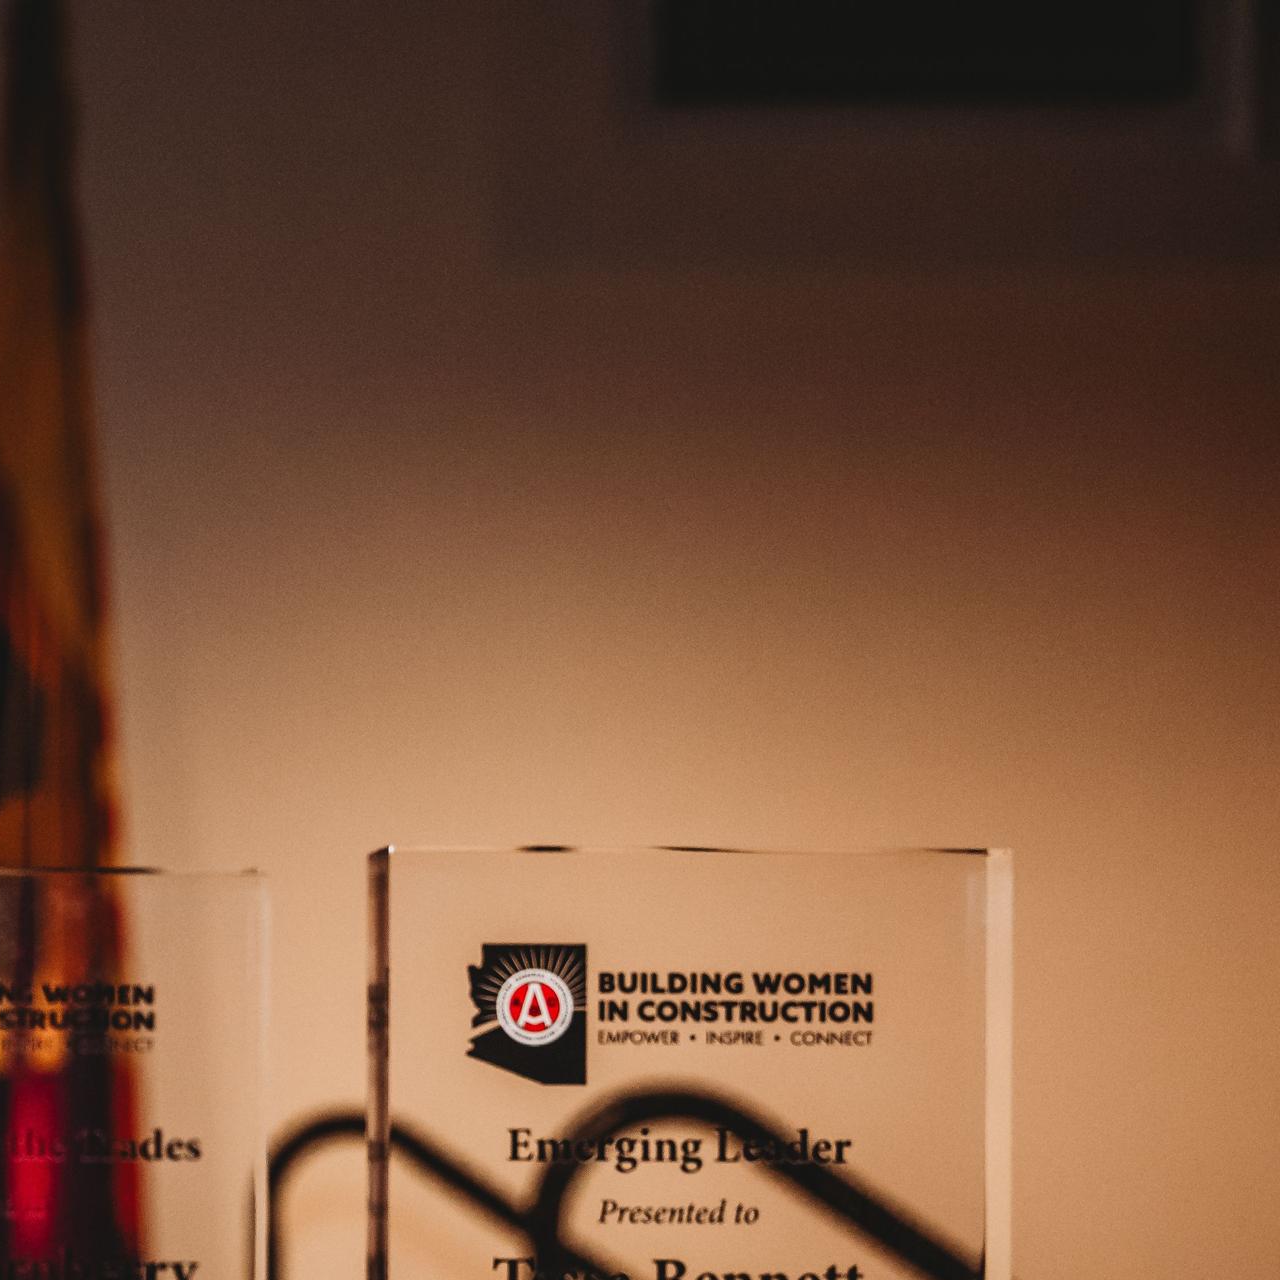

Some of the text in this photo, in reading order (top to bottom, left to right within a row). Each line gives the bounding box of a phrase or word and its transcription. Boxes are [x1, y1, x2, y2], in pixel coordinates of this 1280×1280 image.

[43, 985, 155, 1005] WOMEN
[597, 972, 873, 995] BUILDING WOMEN
[597, 1000, 874, 1023] IN CONSTRUCTION
[597, 1030, 873, 1046] EMPOWER INSPIRE CONNECT
[507, 1127, 702, 1173] Emerging
[599, 1199, 759, 1225] Presented to
